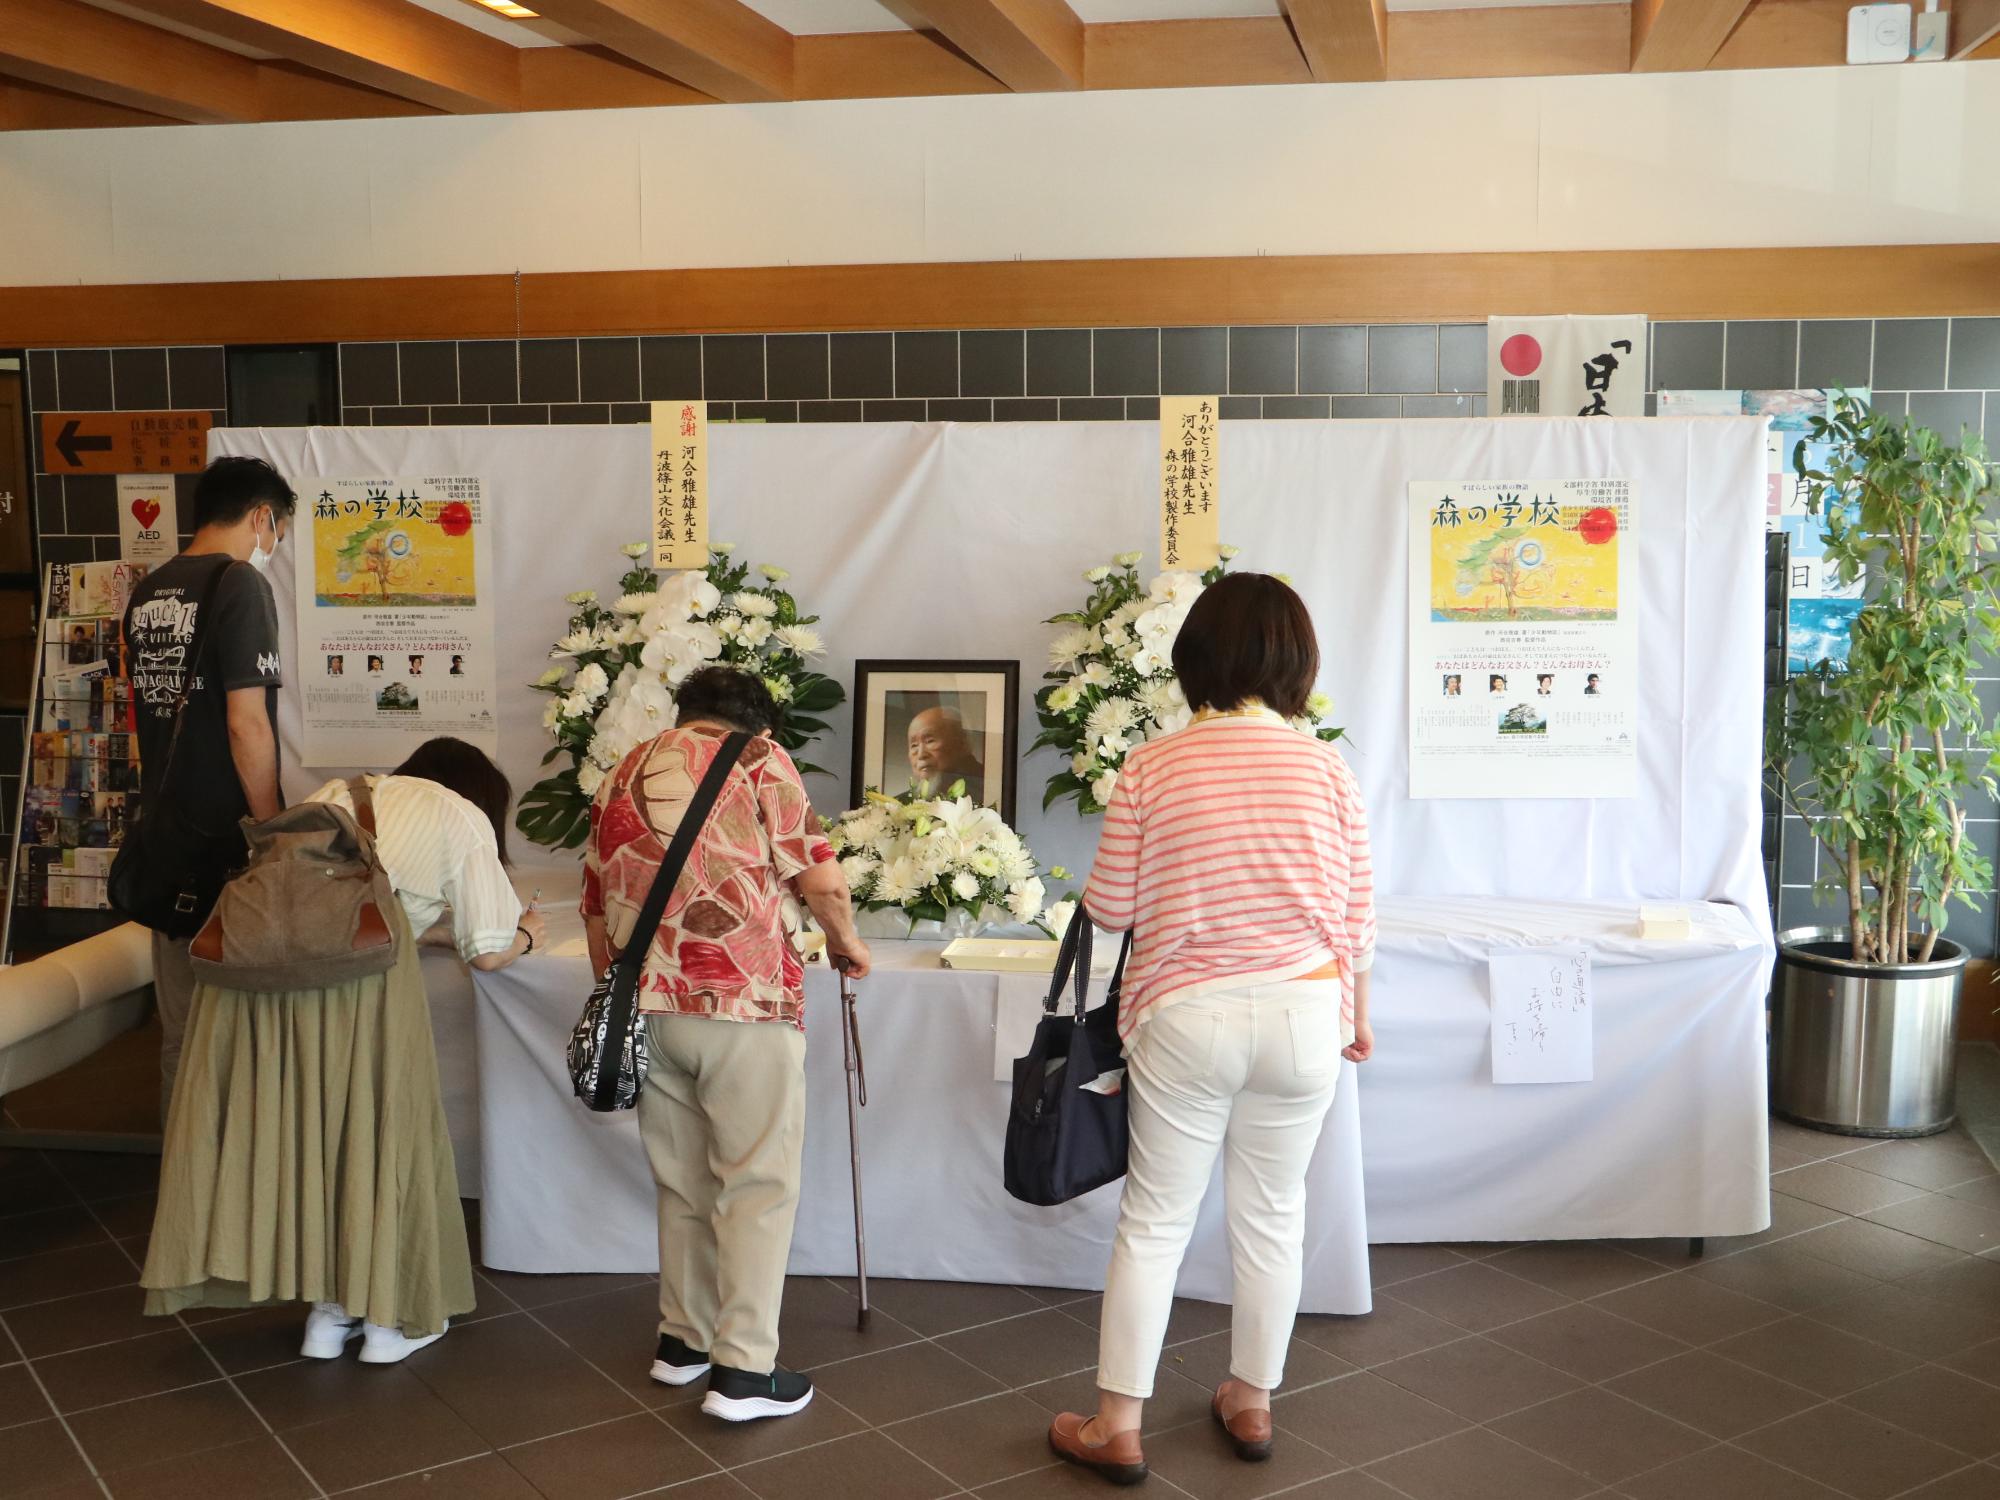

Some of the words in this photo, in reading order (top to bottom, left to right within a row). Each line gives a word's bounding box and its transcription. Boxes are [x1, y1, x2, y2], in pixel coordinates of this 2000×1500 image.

[680, 404, 697, 437] 感謝
[1180, 413, 1199, 515] 河合雅雄先生
[1198, 401, 1215, 512] ありがとうございます
[136, 530, 161, 540] AED
[314, 488, 423, 521] 森の学校
[656, 450, 675, 563] 丹波篠山文化会議一同
[681, 445, 698, 543] 河合雅雄先生
[1164, 448, 1180, 565] 森の学校製作委員会
[1432, 492, 1561, 528] 森の学校
